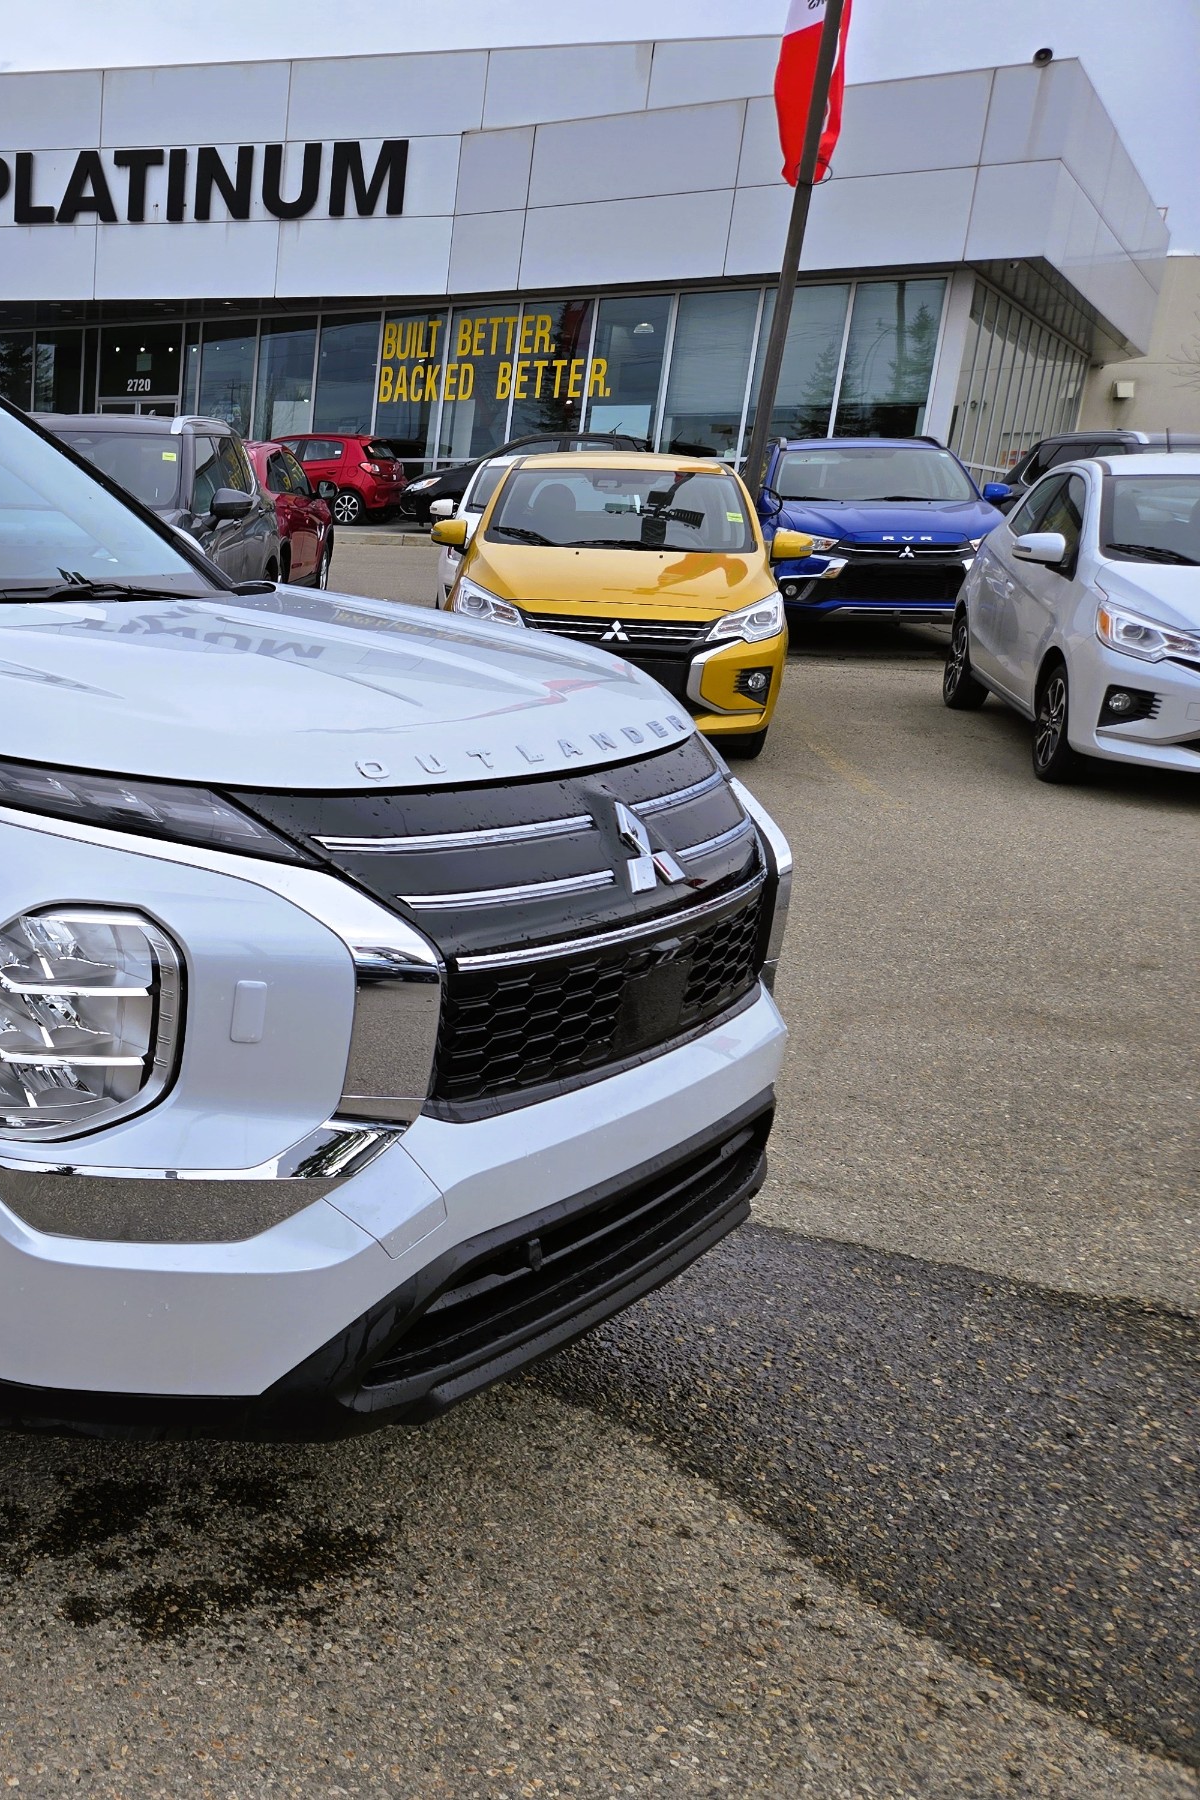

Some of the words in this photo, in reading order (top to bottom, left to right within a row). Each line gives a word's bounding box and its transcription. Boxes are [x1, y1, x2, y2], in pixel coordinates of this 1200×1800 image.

[382, 320, 442, 360] BUILT
[456, 315, 556, 357] BETTER.
[126, 378, 151, 392] 2720
[378, 363, 475, 403] BACKED
[496, 358, 612, 400] BETTER.
[355, 714, 687, 780] OUTLANDER
